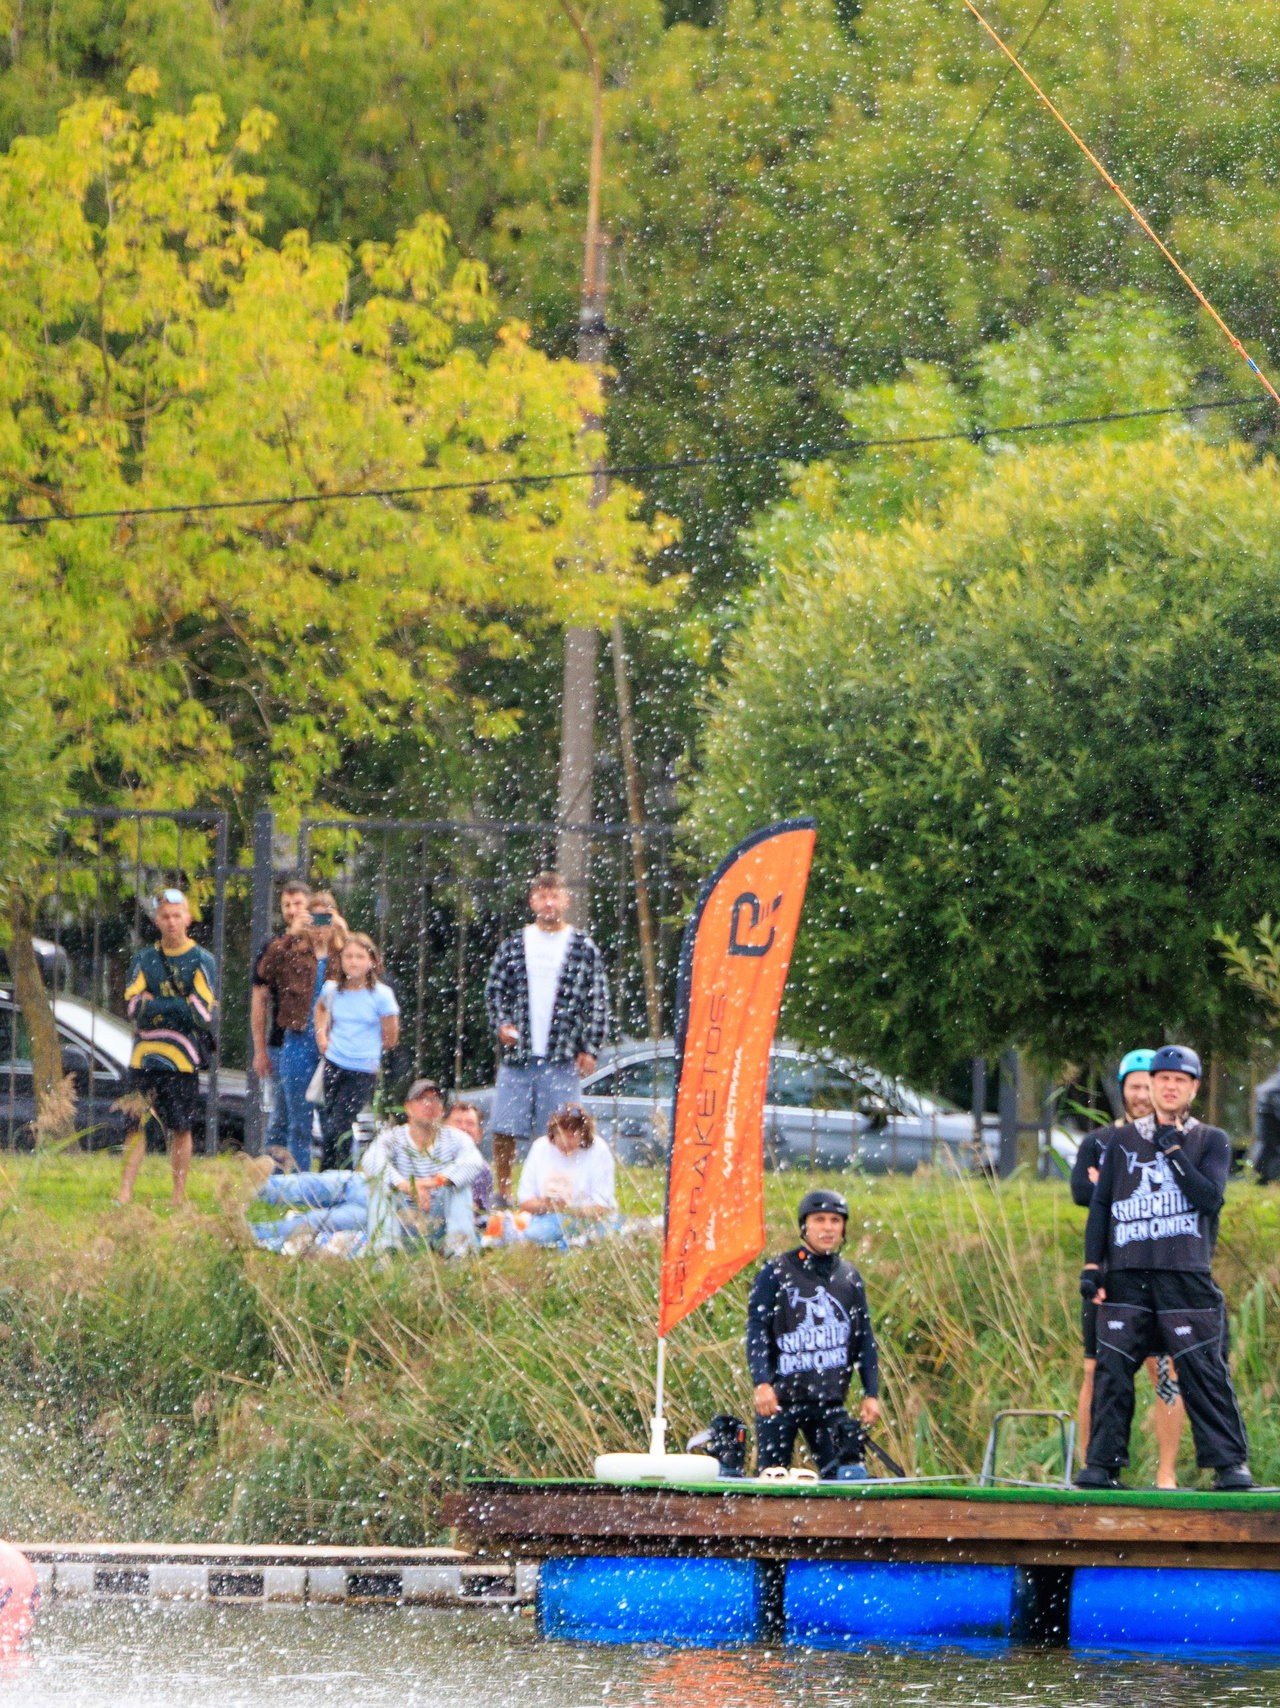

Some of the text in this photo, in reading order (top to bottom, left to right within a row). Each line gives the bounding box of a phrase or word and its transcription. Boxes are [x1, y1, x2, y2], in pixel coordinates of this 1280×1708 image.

[728, 1047, 744, 1143] ЭКСТРИМА
[1111, 1190, 1193, 1222] KUPCHIN
[1114, 1212, 1202, 1247] OPEN CONTEST
